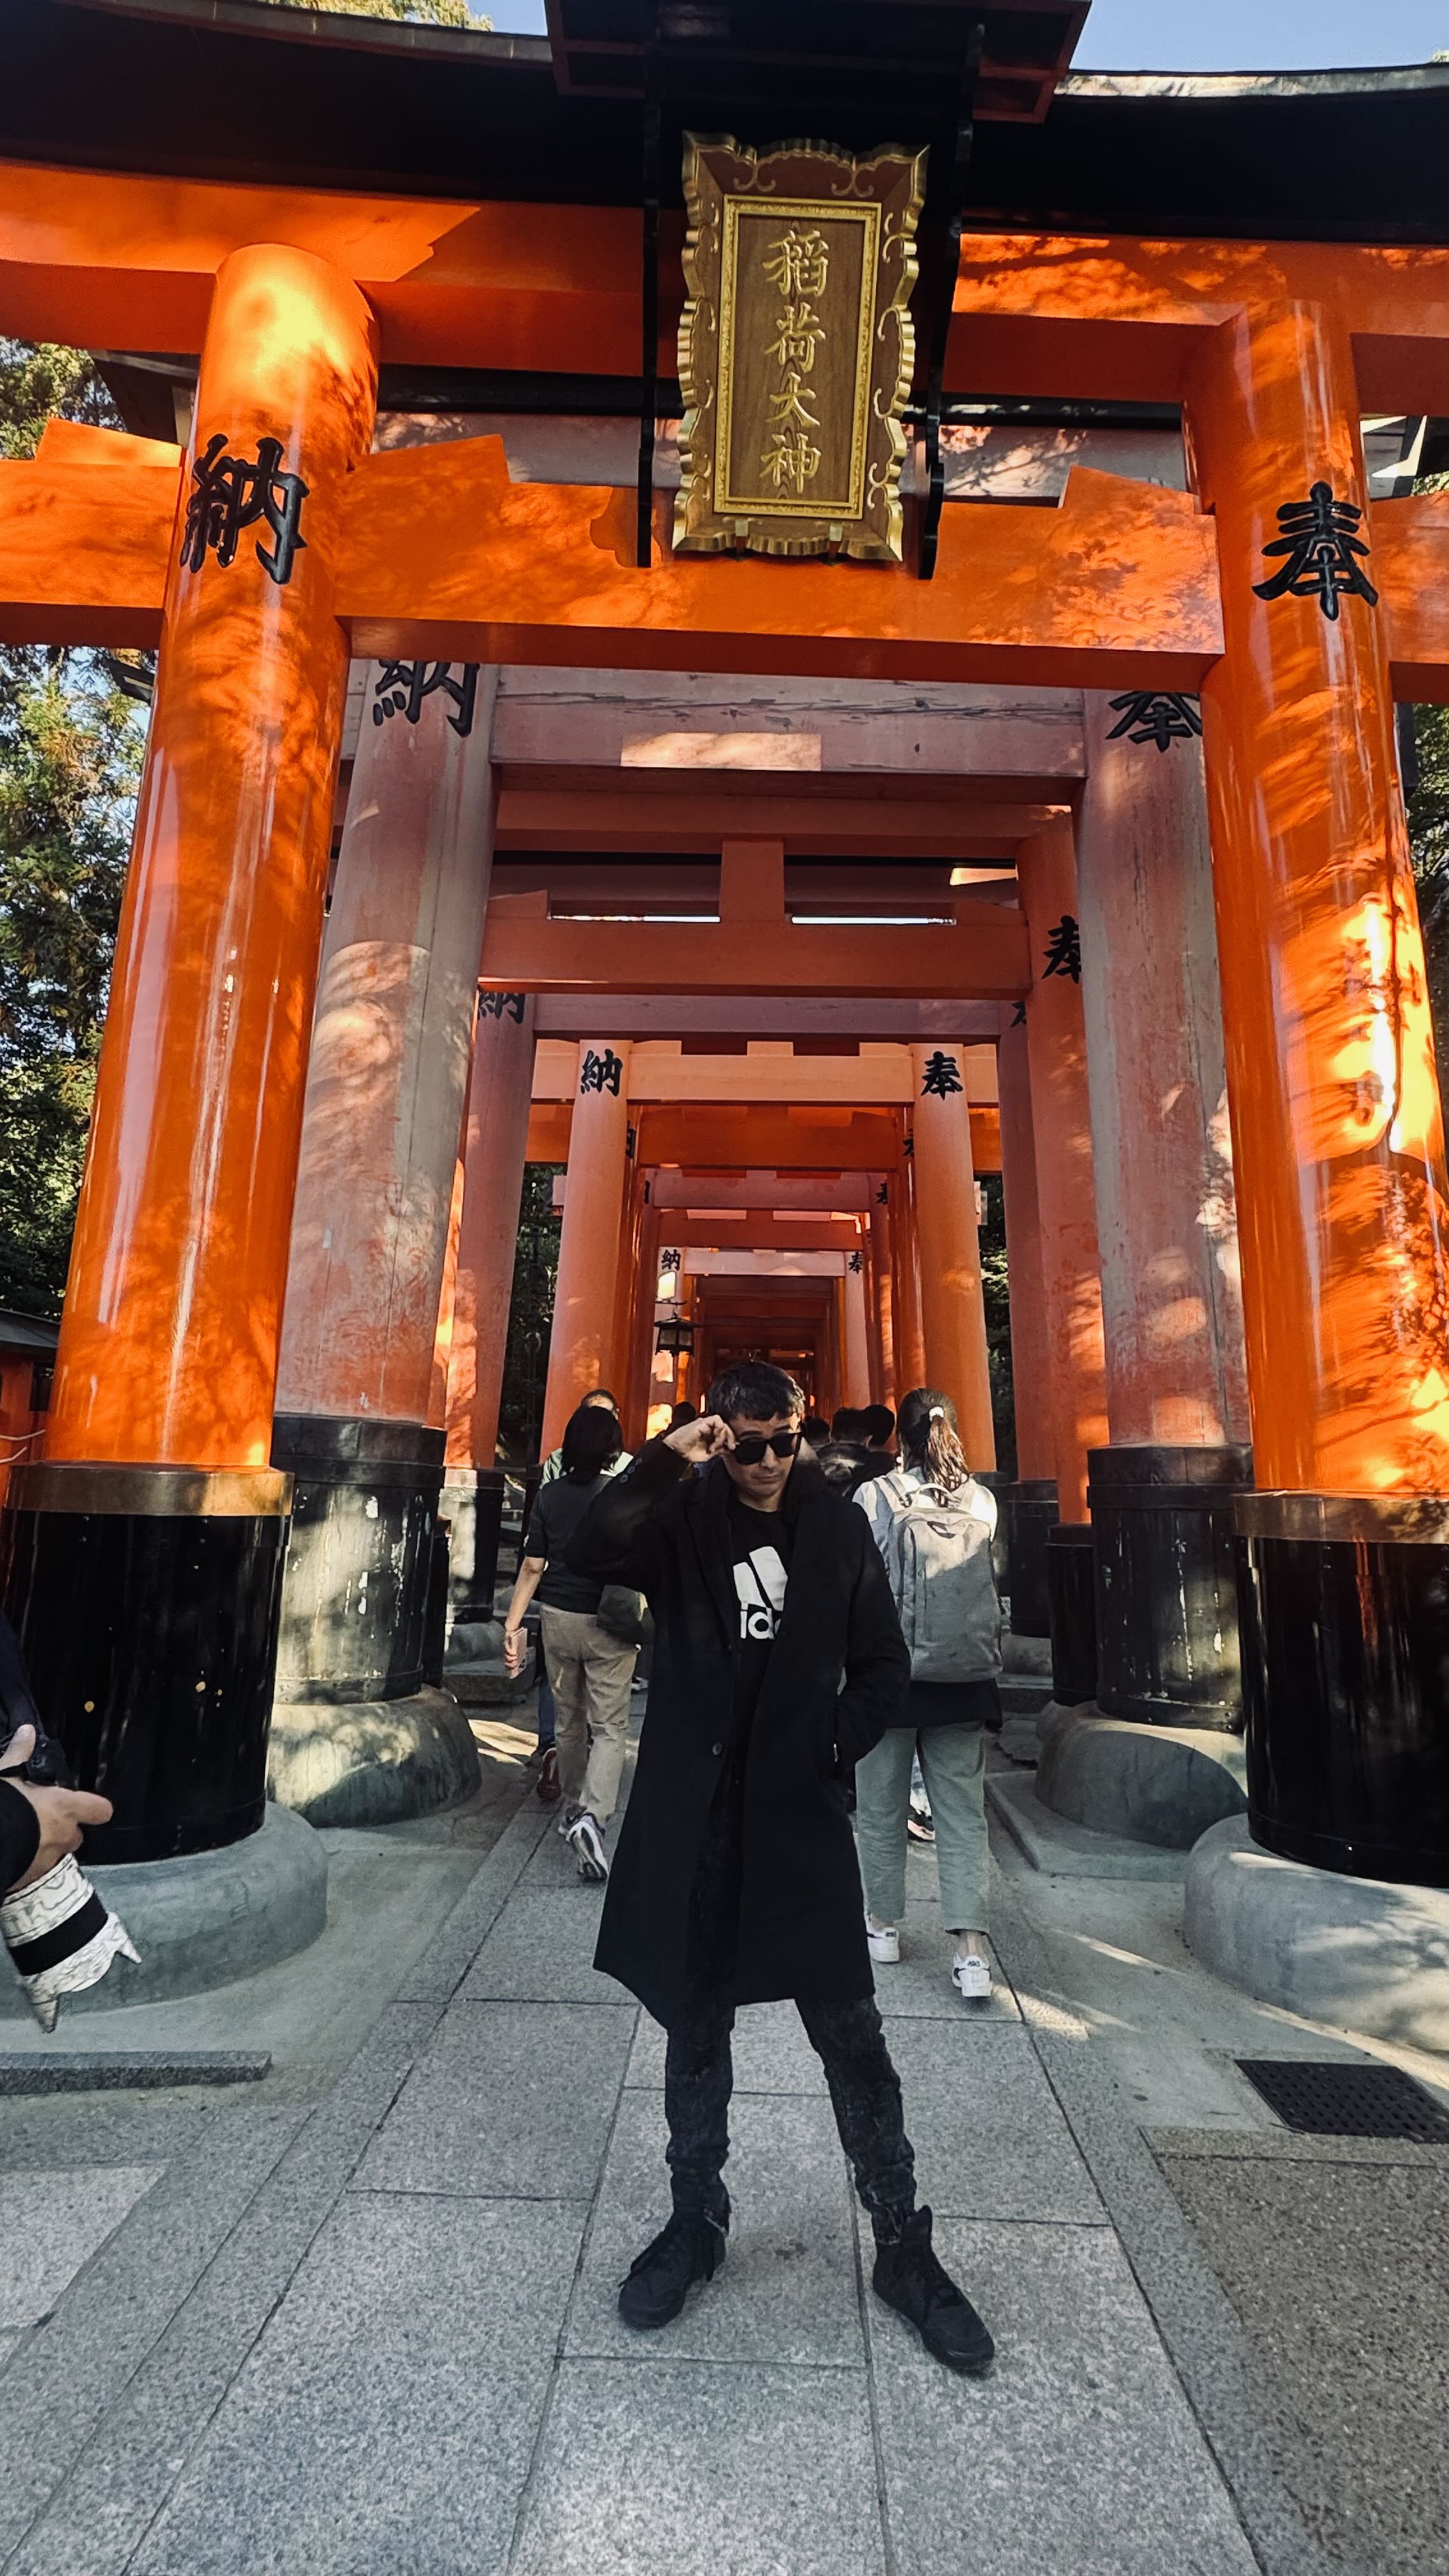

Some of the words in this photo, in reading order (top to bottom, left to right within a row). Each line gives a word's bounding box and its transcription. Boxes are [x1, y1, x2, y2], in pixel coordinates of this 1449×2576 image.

[180, 433, 310, 585] 納
[1252, 480, 1378, 621] 奉
[581, 1048, 623, 1097] 納
[921, 1051, 963, 1100] 奉
